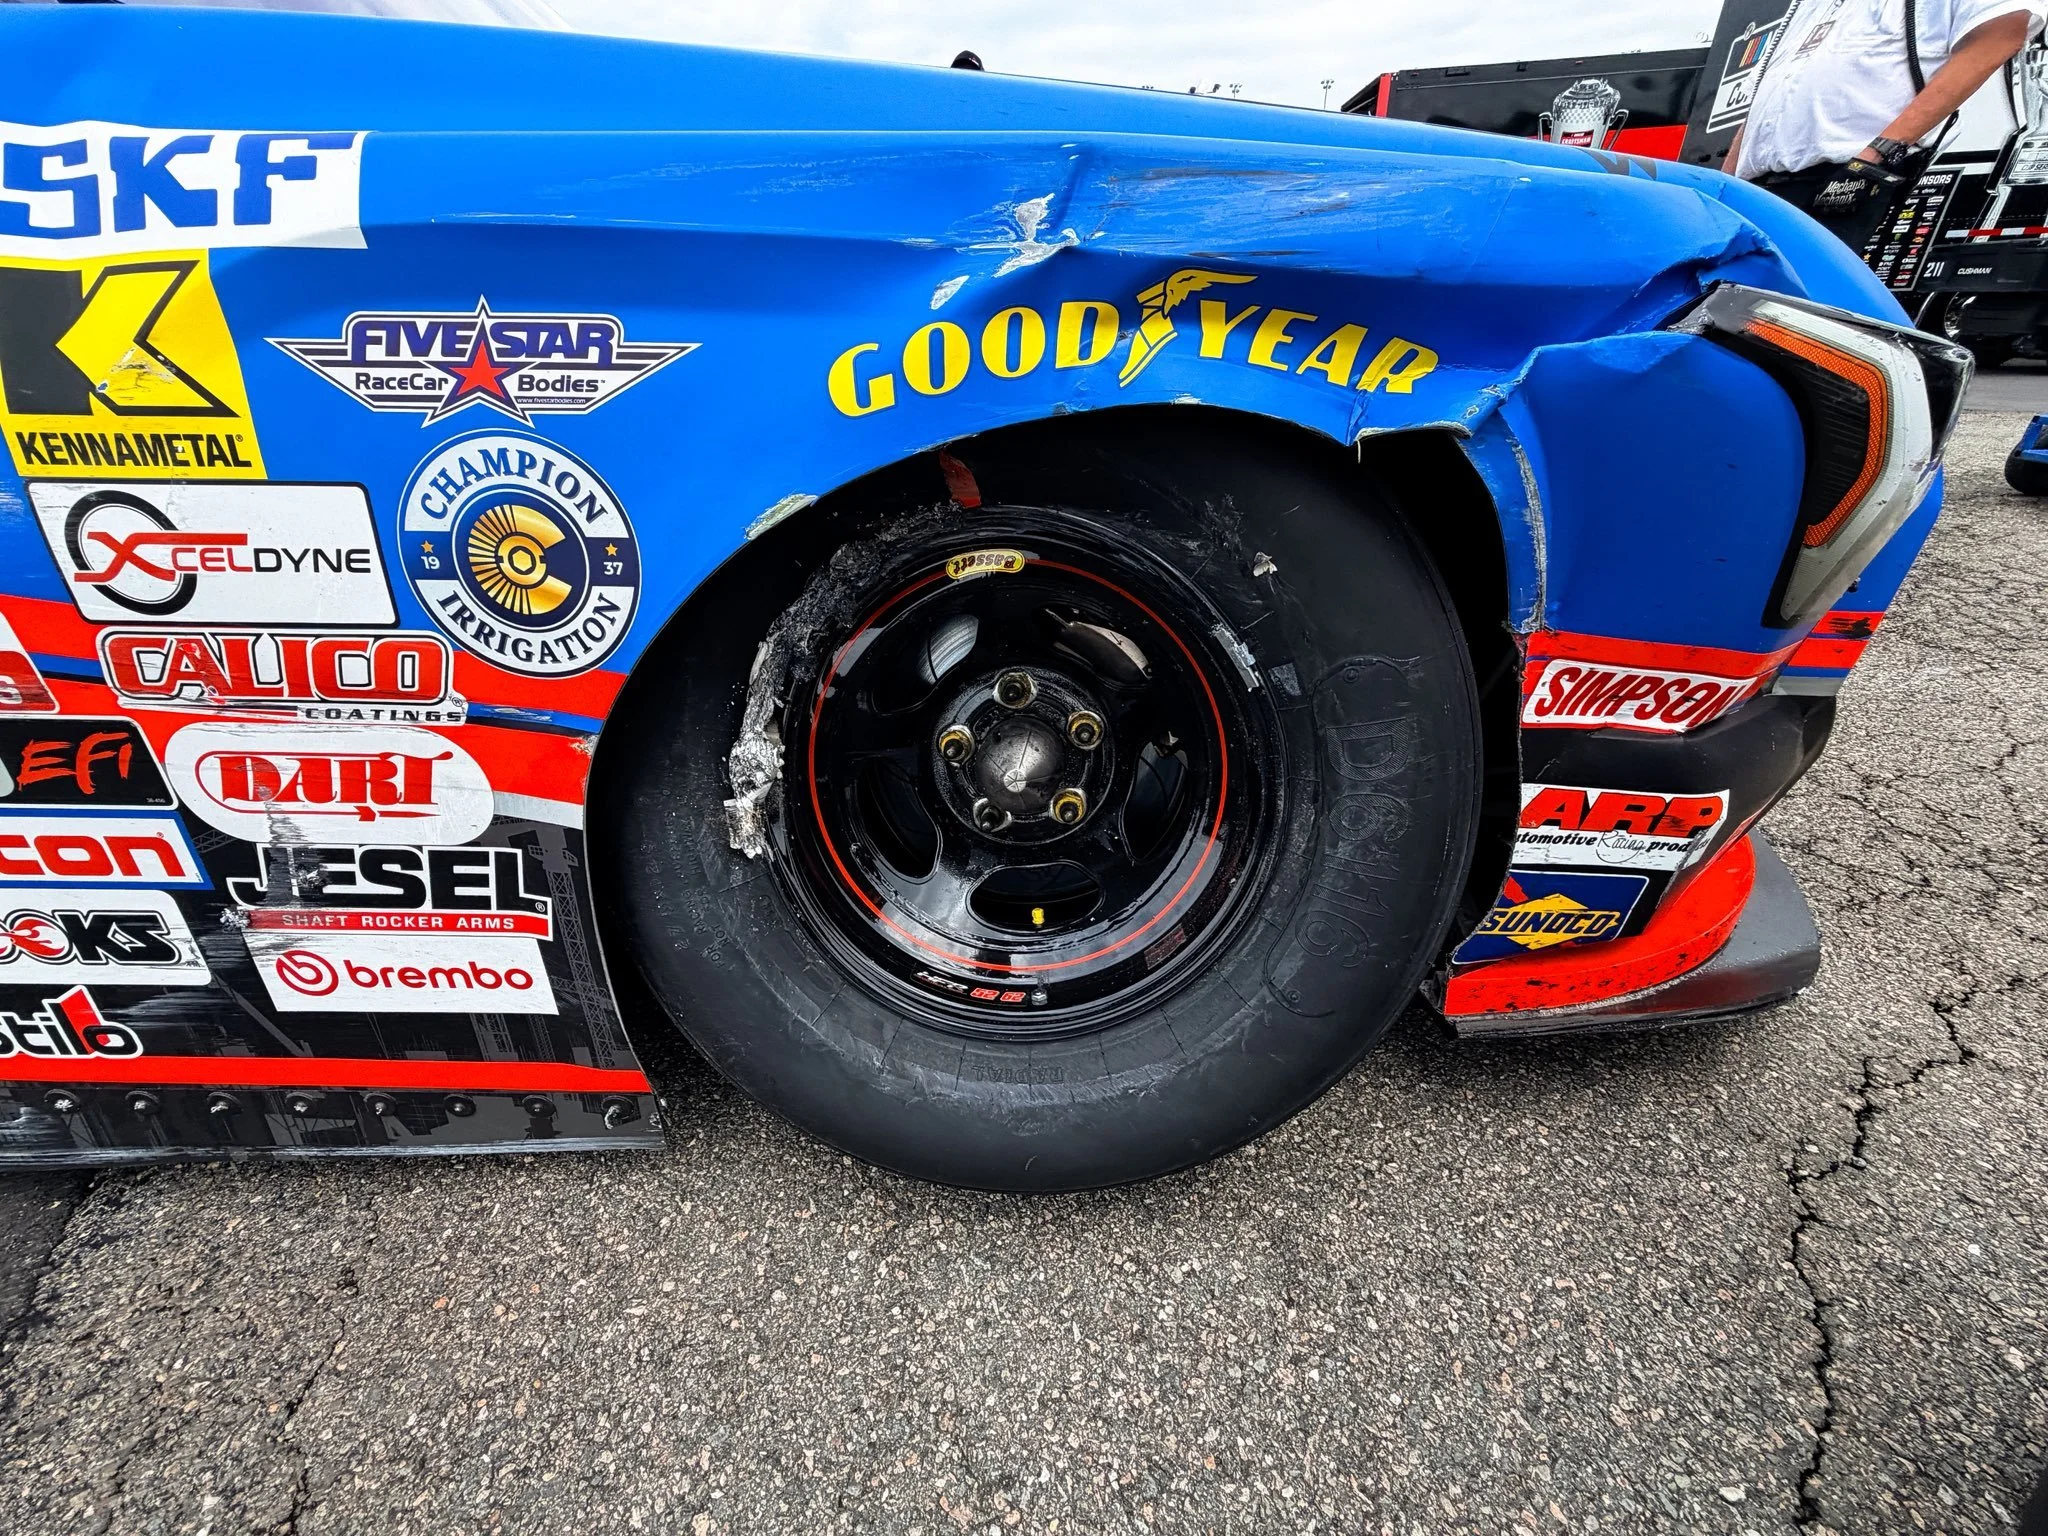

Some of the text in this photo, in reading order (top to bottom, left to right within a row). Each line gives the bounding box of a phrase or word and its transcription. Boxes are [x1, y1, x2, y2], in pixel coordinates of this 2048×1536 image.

[0, 132, 358, 239] SKF
[1924, 262, 1945, 277] 211
[1957, 267, 1993, 275] CUSHMAN
[351, 320, 615, 367] FIVE STAR
[355, 372, 599, 392] RaceCar Bodies
[15, 430, 252, 469] KENNAMETAL
[420, 447, 608, 525] CHAMPION
[74, 531, 371, 582] XCELDYNE
[421, 555, 440, 570] 19
[603, 561, 623, 576] 37
[435, 590, 622, 666] IRRIGATION
[102, 632, 449, 703] CALICO
[305, 708, 462, 722] COATINGS
[1535, 666, 1752, 729] SIMPSON
[213, 751, 454, 806] DART
[1520, 787, 1724, 839] ARP
[1516, 831, 1598, 846] utomotive
[1597, 830, 1646, 853] Racing
[227, 845, 550, 914] JESEL
[0, 908, 183, 966] OKS
[282, 914, 516, 930] SHAFT ROCKER ARMS
[1485, 911, 1617, 934] SUNOCO
[347, 954, 533, 990] brembo
